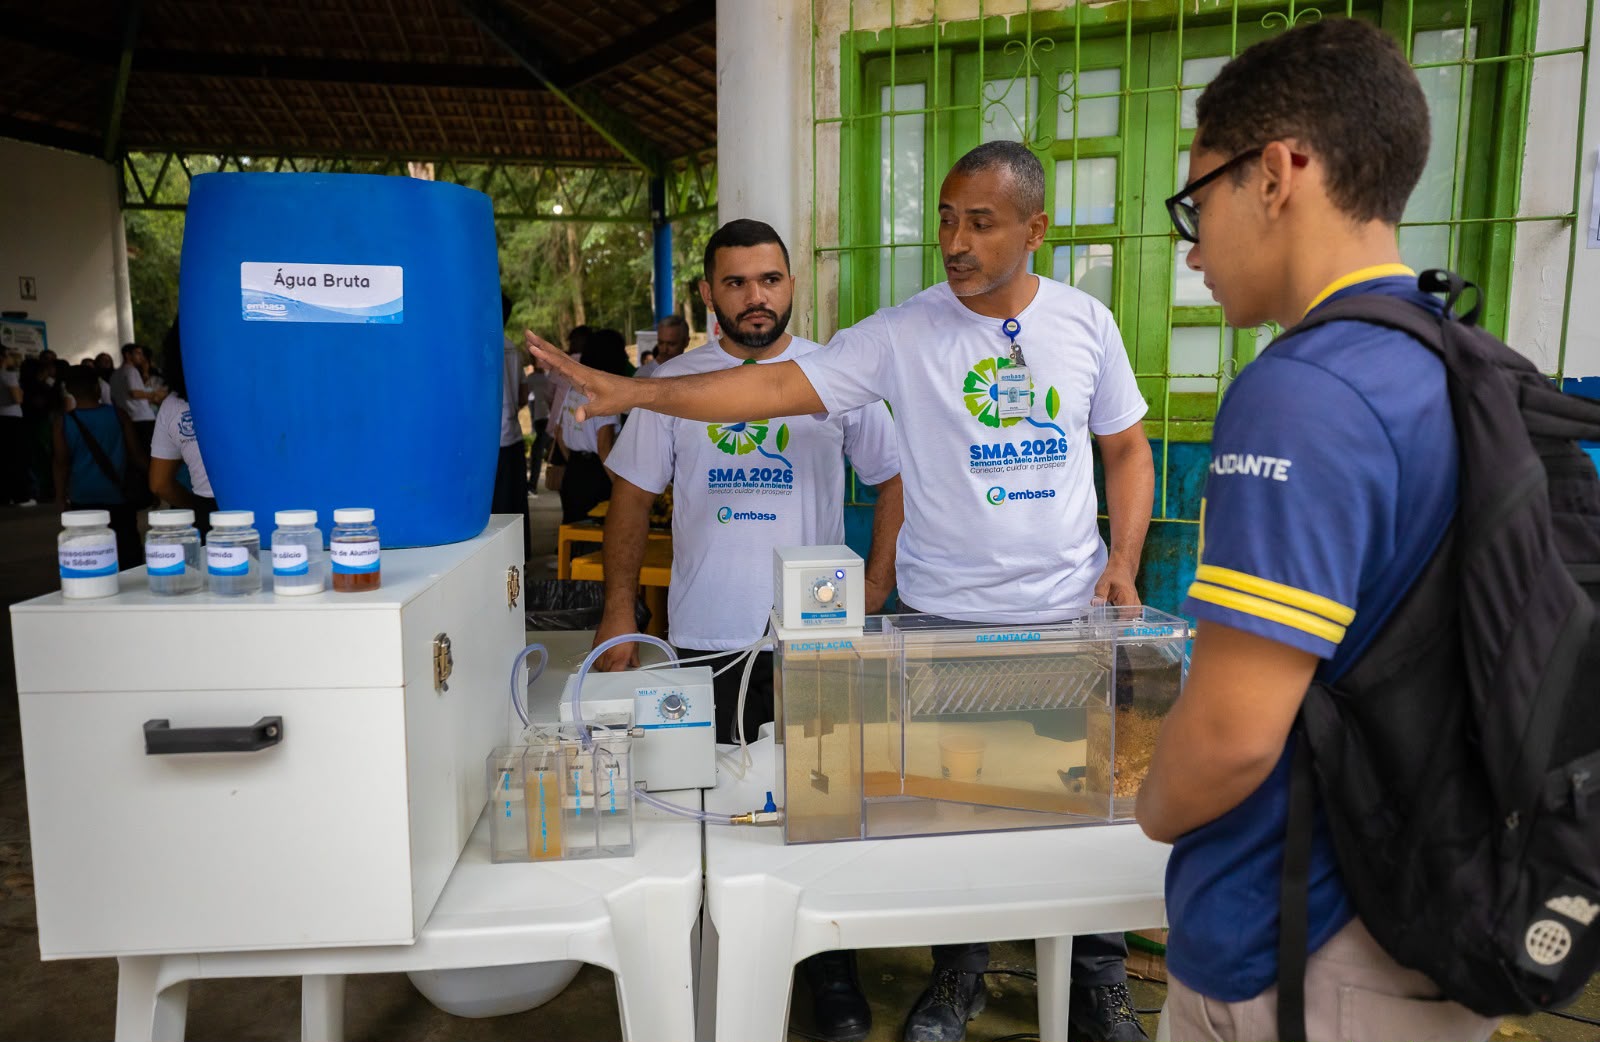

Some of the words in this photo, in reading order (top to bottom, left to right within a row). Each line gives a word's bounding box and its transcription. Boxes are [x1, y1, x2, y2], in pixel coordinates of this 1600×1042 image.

[274, 268, 317, 290] Água
[323, 273, 370, 288] Bruta
[246, 301, 287, 311] embasa
[969, 443, 1018, 460] SMA
[1020, 438, 1068, 456] 2026
[1006, 464, 1029, 472] cuidar
[708, 468, 747, 482] SMA
[749, 468, 794, 483] 2026
[760, 482, 793, 490] Ambiente
[1008, 489, 1056, 501] embasa
[733, 511, 777, 521] embasa
[976, 631, 1041, 643] DECANTAÇÃO
[790, 640, 853, 652] FLOCULAÇÃO
